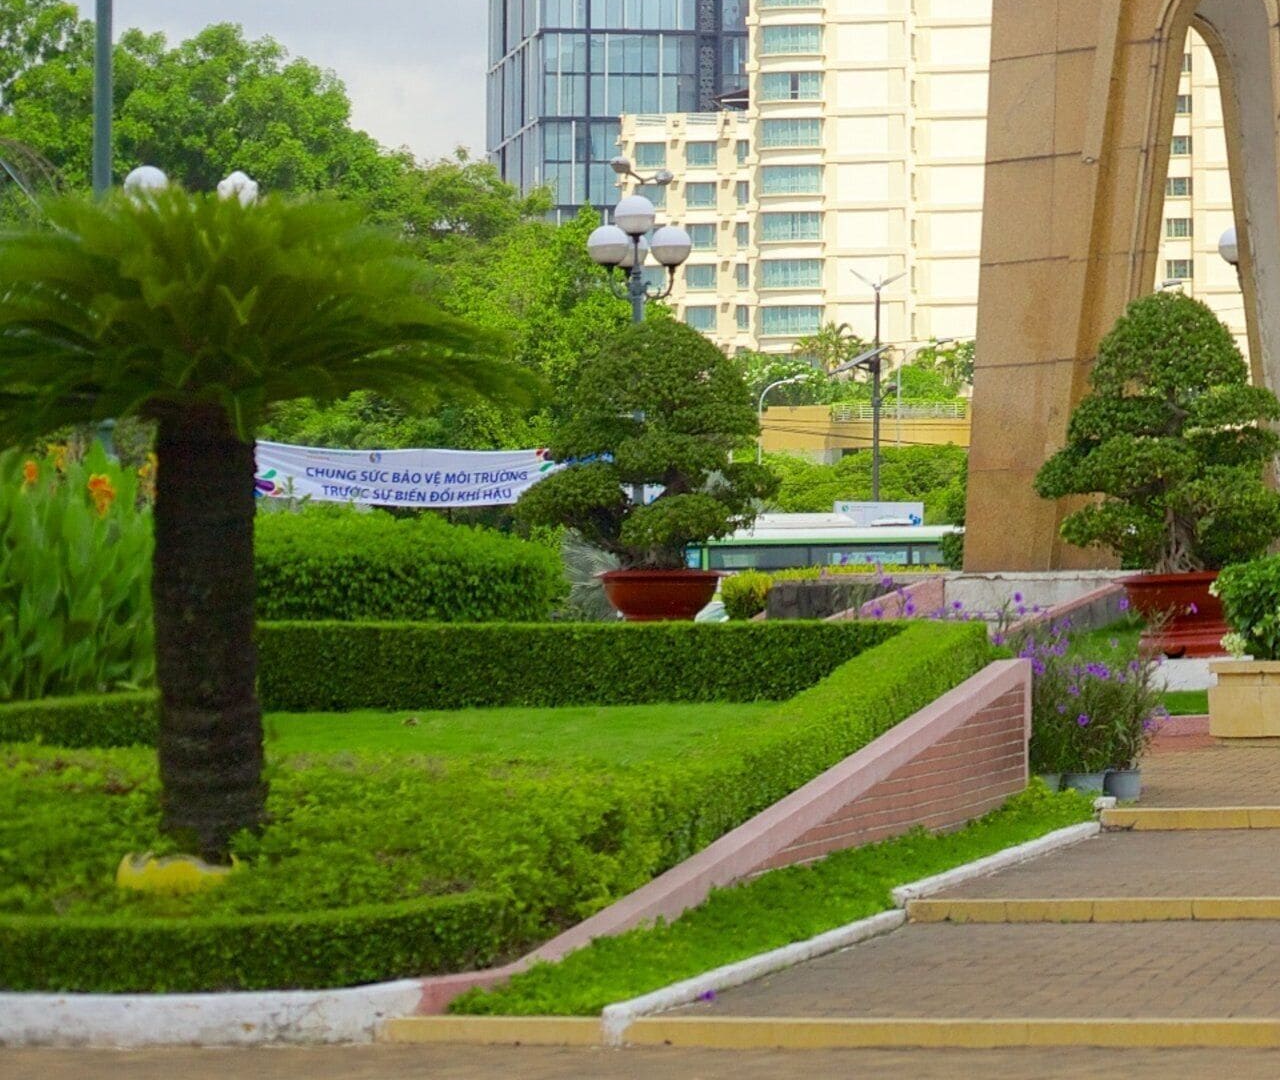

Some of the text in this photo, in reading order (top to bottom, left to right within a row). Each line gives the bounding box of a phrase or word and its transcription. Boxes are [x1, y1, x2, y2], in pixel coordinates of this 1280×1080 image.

[306, 467, 528, 487] CHUNG SỨC BẢO VỆ MÔI TRƯỜNG
[322, 484, 512, 503] TRƯỚC SỰ BIẾN ĐỔI KHÍ HẬU
